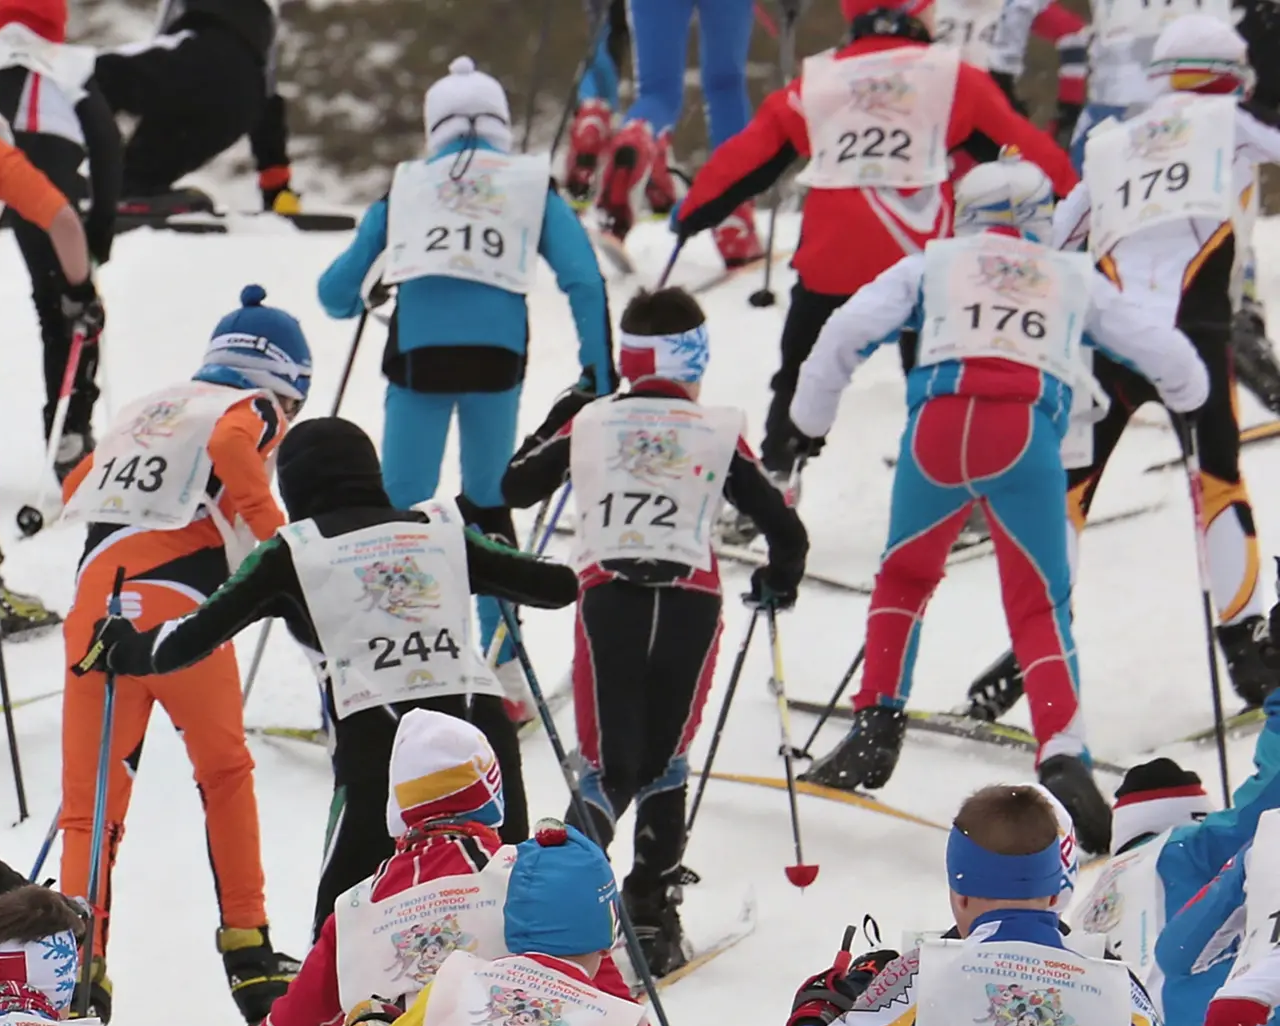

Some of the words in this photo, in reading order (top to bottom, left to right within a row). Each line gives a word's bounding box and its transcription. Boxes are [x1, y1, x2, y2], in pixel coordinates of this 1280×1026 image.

[837, 127, 912, 163] 222
[1117, 162, 1190, 208] 179
[427, 225, 504, 258] 219
[965, 304, 1045, 338] 176
[97, 455, 168, 493] 143
[600, 493, 678, 528] 172
[369, 629, 459, 670] 244
[961, 964, 1016, 978] CASTELLO
[1020, 972, 1032, 981] DI
[1036, 976, 1075, 988] FIEMME
[994, 960, 1012, 969] SCI
[1016, 963, 1027, 972] DI
[1032, 966, 1071, 980] FONDO
[998, 952, 1040, 966] TROFEO
